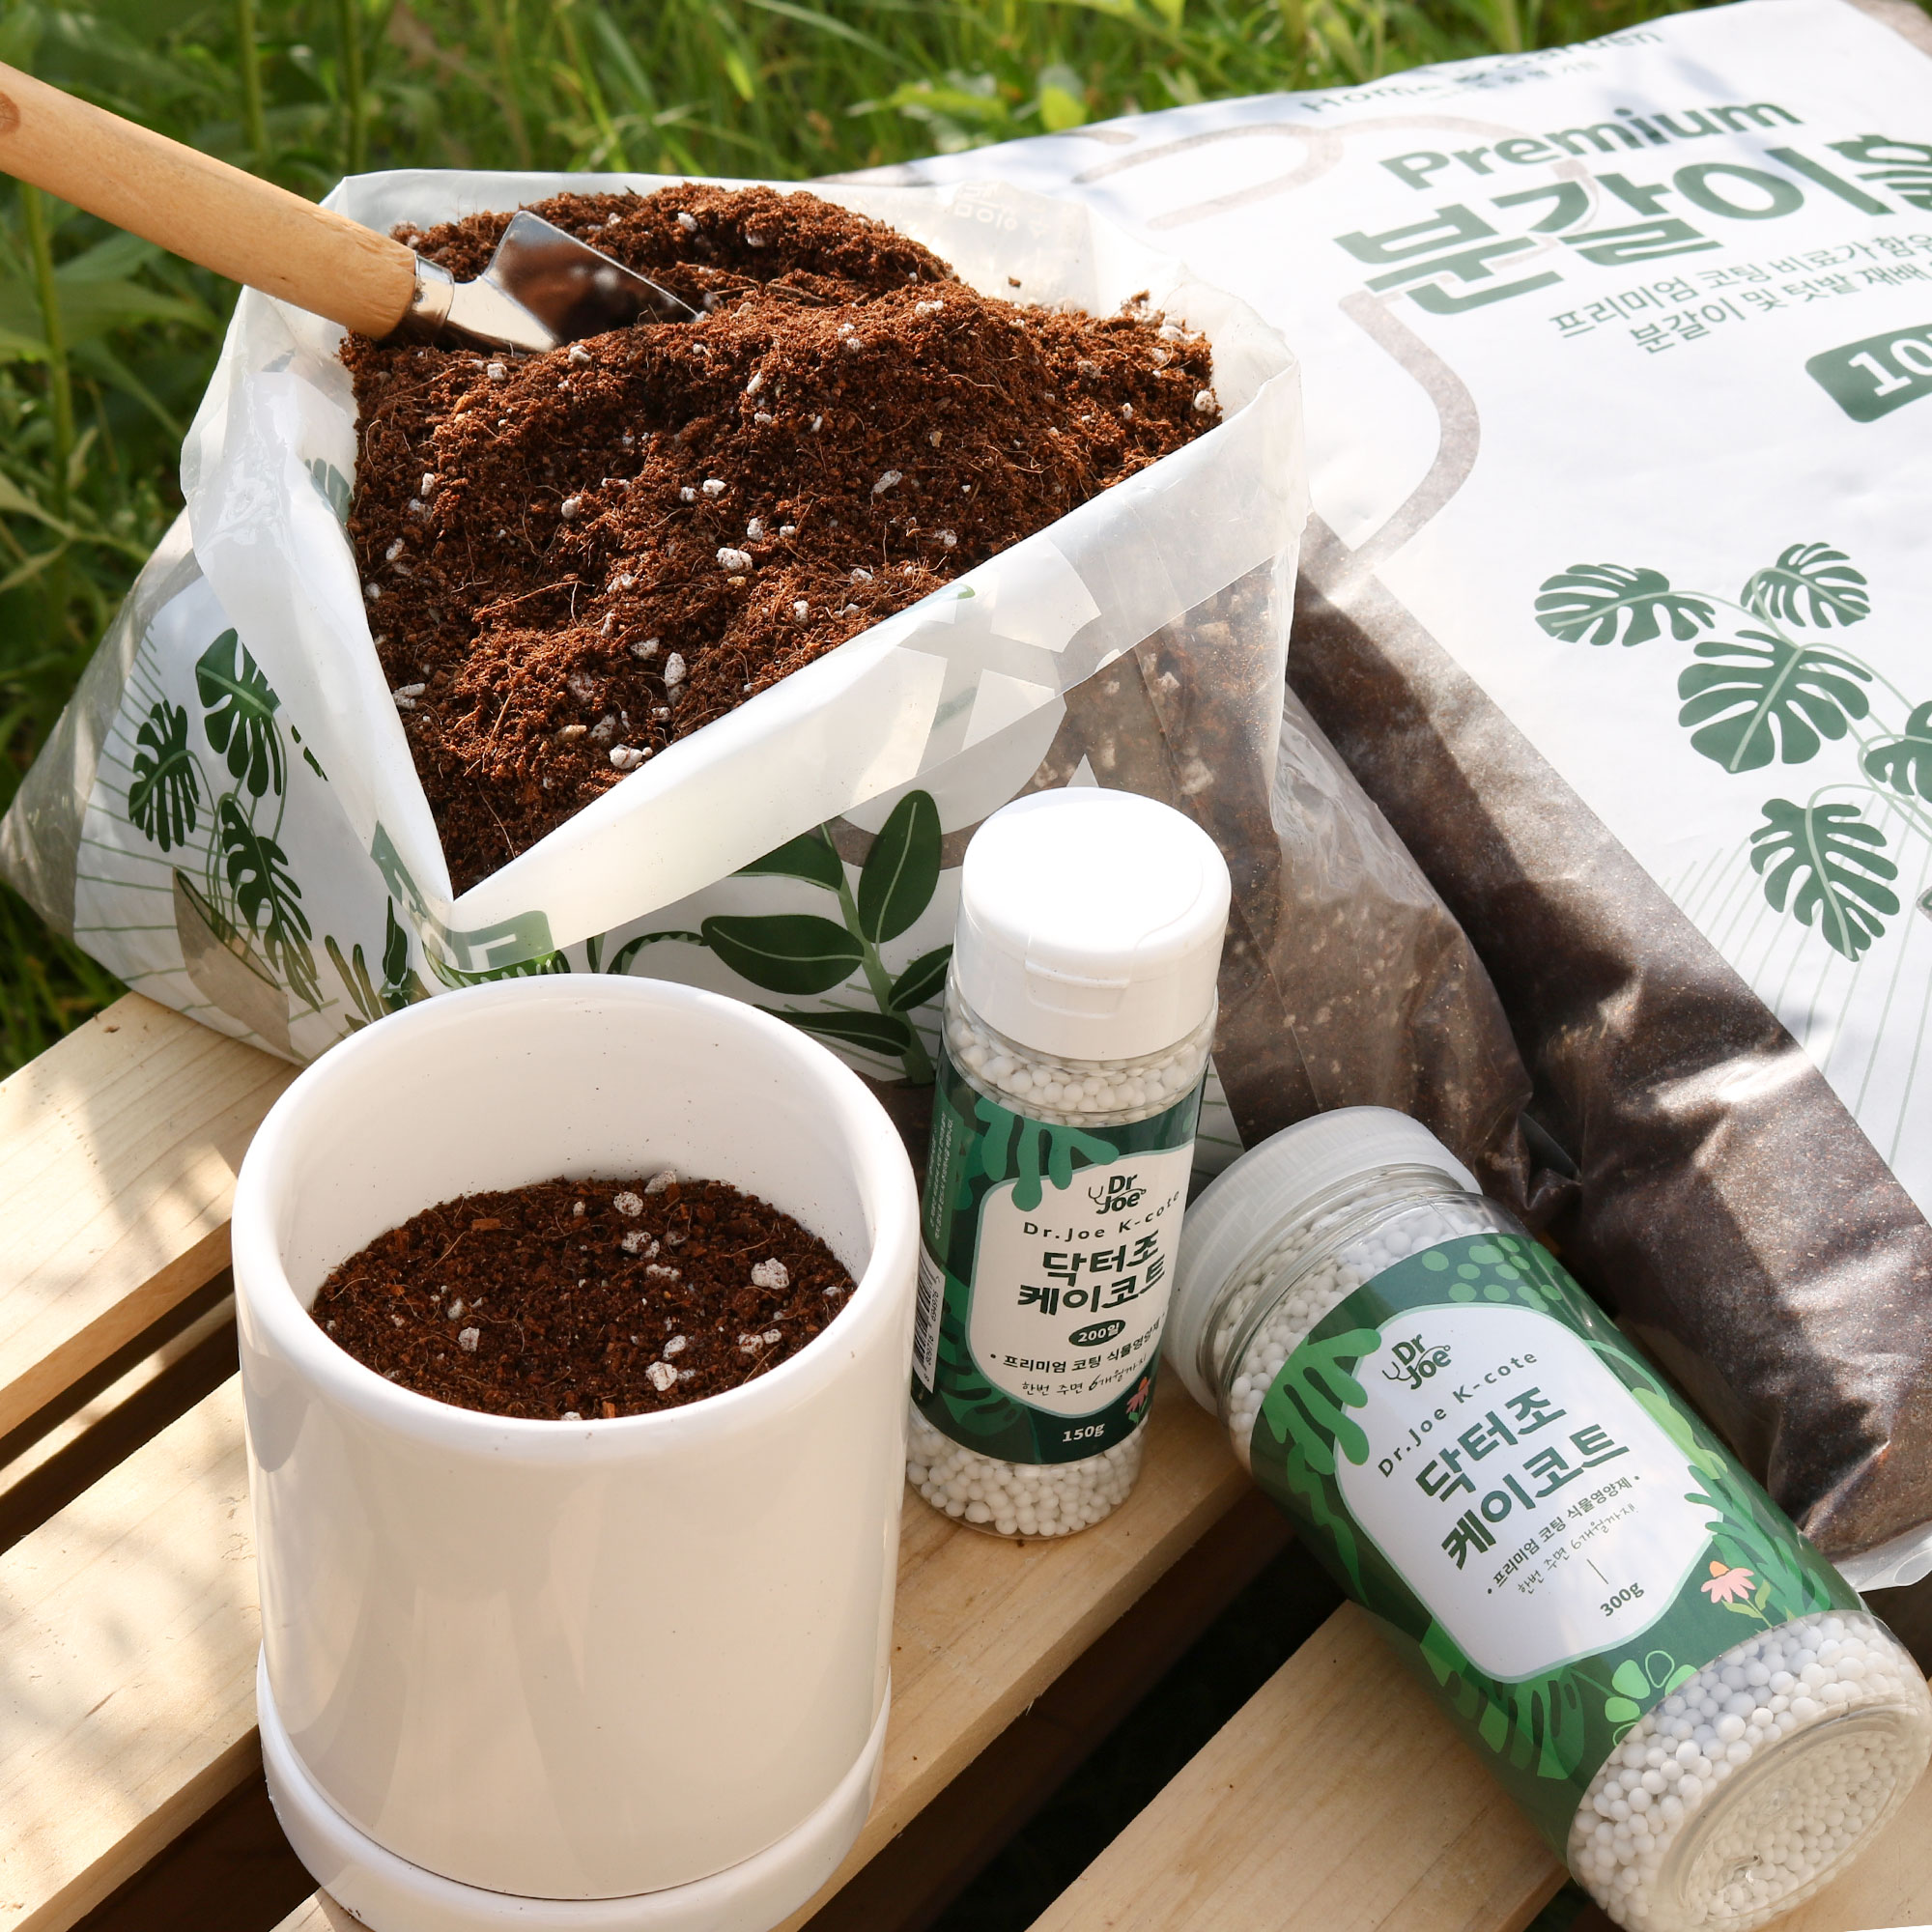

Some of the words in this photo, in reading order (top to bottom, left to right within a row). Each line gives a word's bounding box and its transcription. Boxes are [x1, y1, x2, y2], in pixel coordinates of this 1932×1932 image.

[1378, 100, 1805, 190] Premium
[1548, 276, 1700, 338] 프리미엄
[1696, 262, 1773, 290] 코팅
[1769, 242, 1878, 273] 비료가
[1630, 298, 1746, 354] 분갈이
[1741, 288, 1789, 312] 및
[1783, 272, 1861, 303] 텃밭
[1095, 1191, 1141, 1215] Joe
[1107, 1174, 1139, 1195] Dr
[1023, 1221, 1106, 1243] Dr.Joe
[1119, 1190, 1180, 1235] K-cote
[1042, 1229, 1159, 1287] 닥터조
[1017, 1254, 1165, 1316] 케이코트
[1077, 1321, 1121, 1343] 200일
[1391, 1333, 1427, 1366] Dr
[1002, 1354, 1067, 1374] 프리미엄
[1071, 1355, 1102, 1372] 코팅
[1021, 1380, 1051, 1396] 한번
[1406, 1350, 1453, 1390] Joe
[1063, 1423, 1106, 1443] 150g
[1378, 1406, 1447, 1478] Dr.Joe
[1452, 1352, 1538, 1404] K-cote
[1414, 1386, 1568, 1503] 닥터조
[1441, 1423, 1631, 1571] 케이코트
[1492, 1538, 1541, 1588] 프리미엄
[1538, 1516, 1567, 1543] 코팅
[1567, 1476, 1633, 1520] 식물영양제
[1518, 1569, 1545, 1595] 한번
[1543, 1547, 1570, 1571] 주면
[1600, 1582, 1645, 1617] 300g
